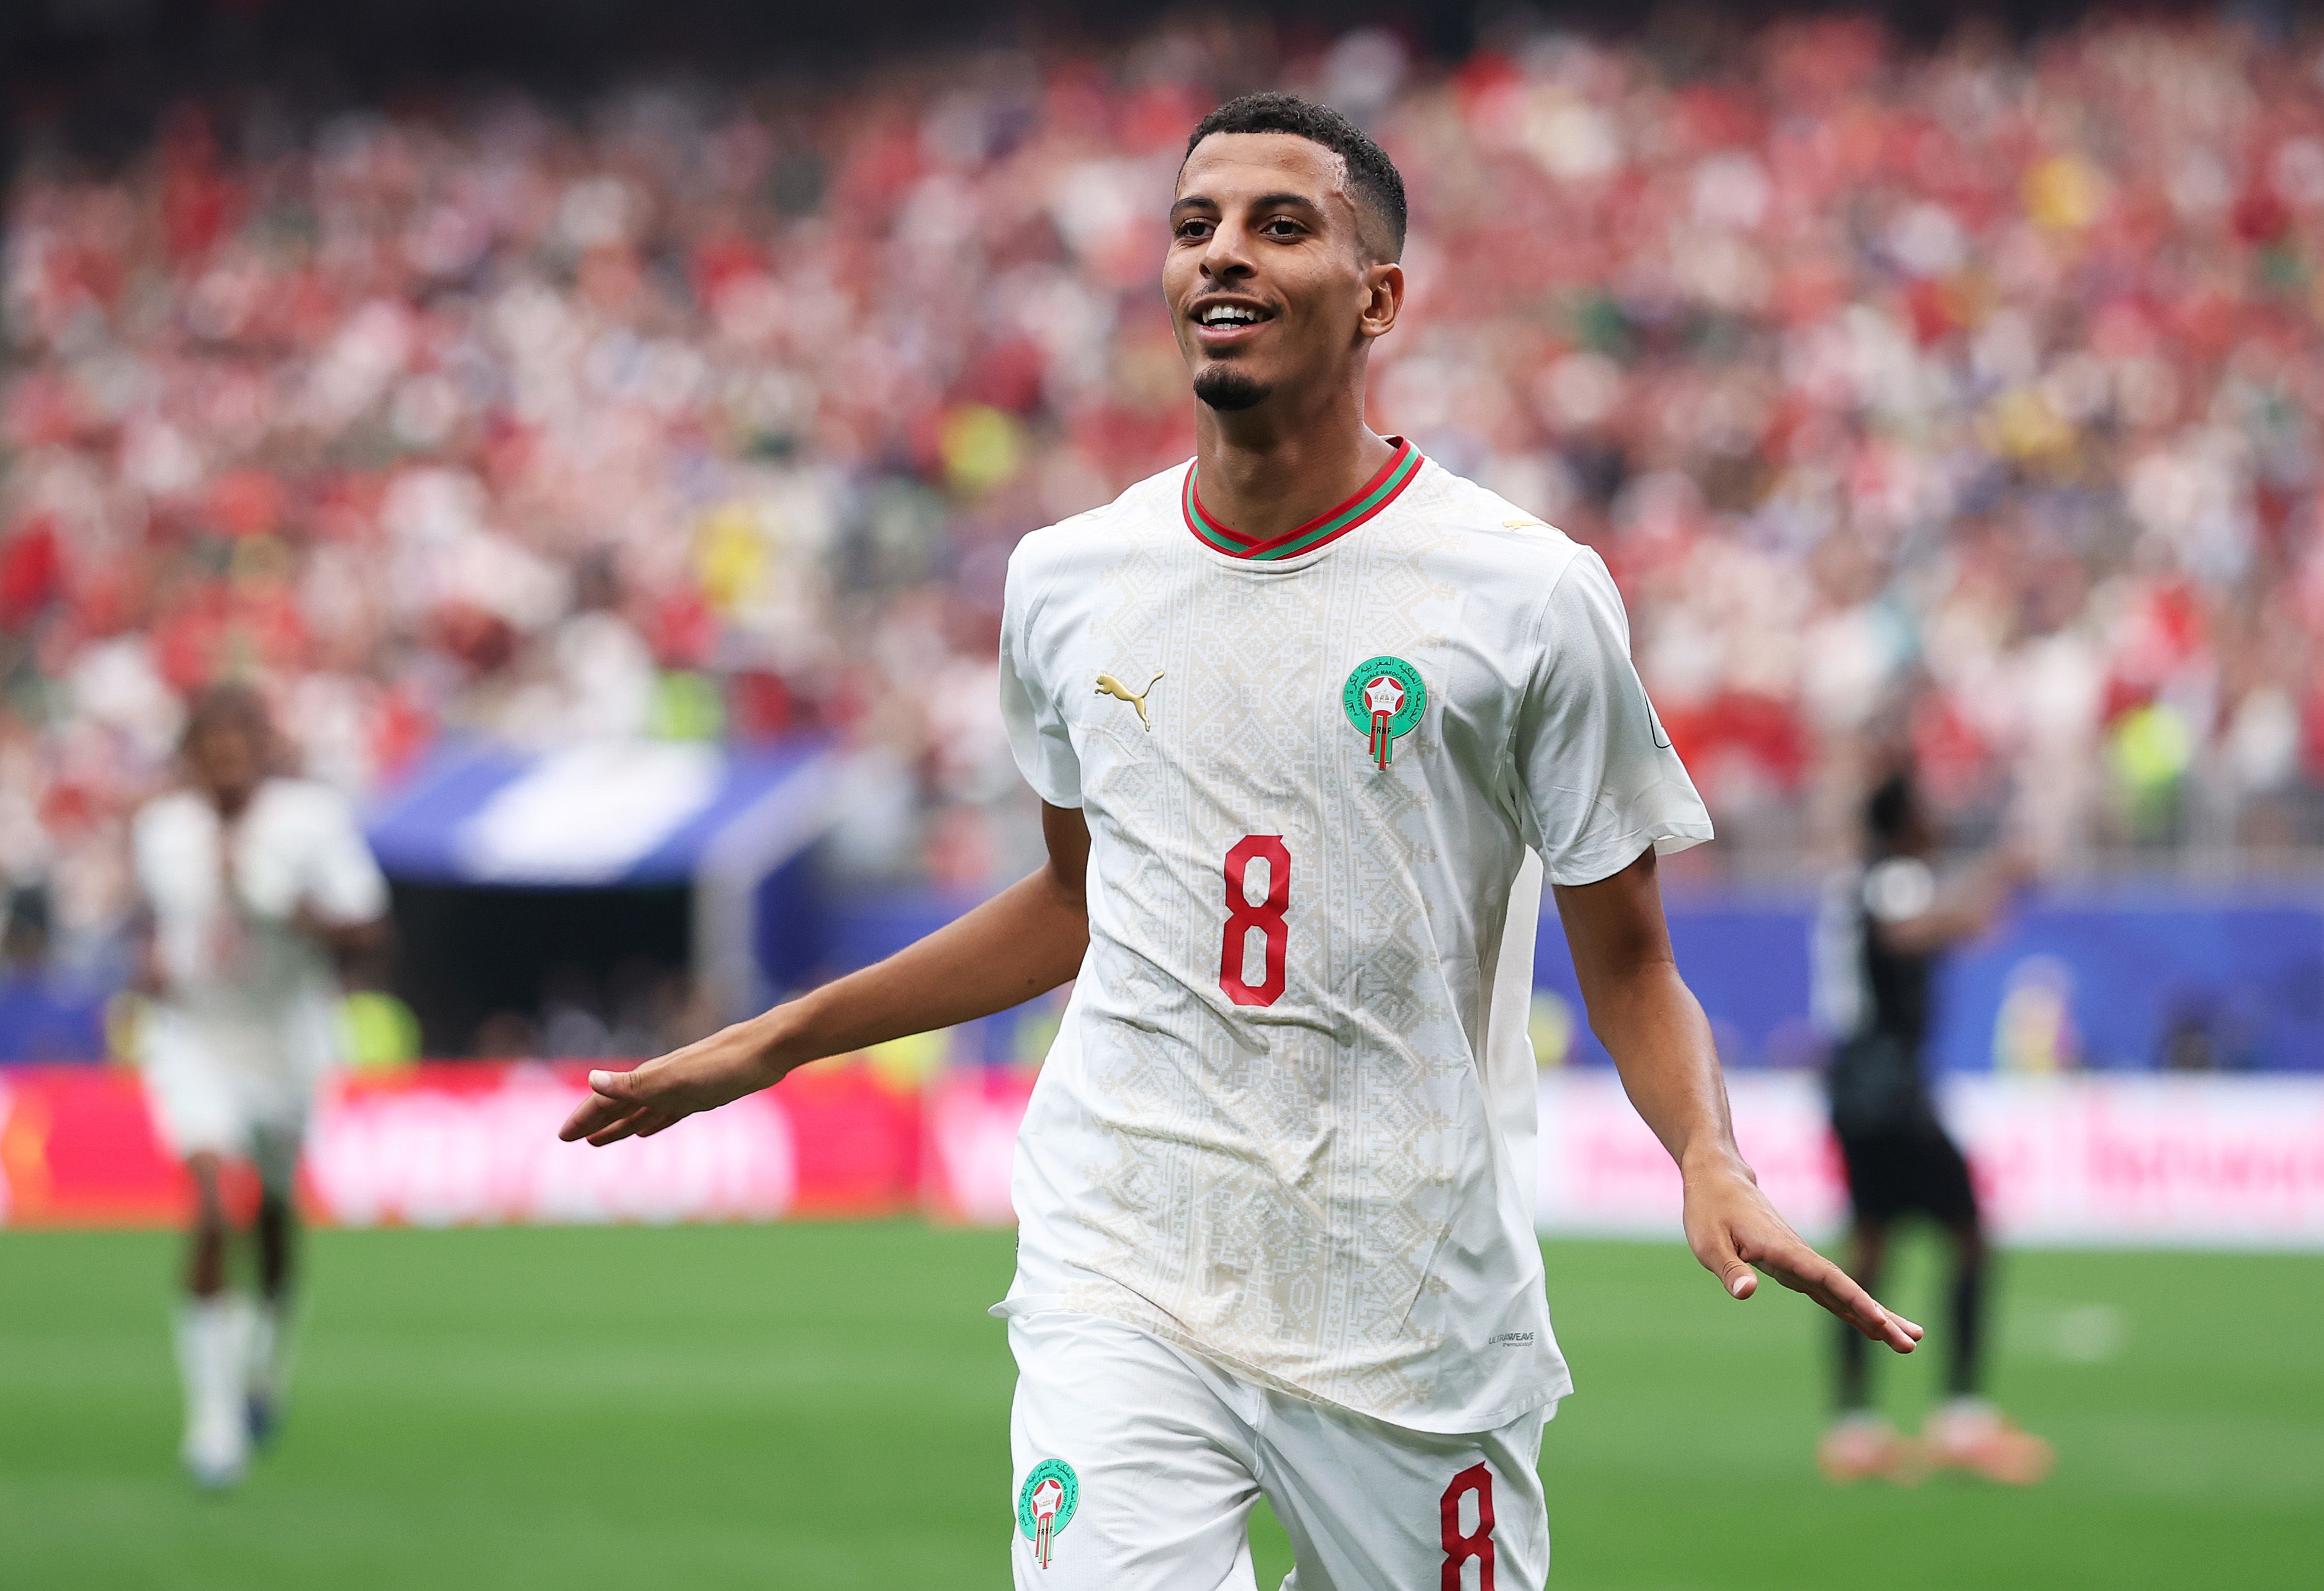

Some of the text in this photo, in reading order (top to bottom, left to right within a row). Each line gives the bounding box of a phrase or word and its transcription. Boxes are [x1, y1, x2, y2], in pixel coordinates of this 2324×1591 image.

[1345, 658, 1425, 724] الجامعة الملكية المغربية لكرة القدم
[1361, 671, 1380, 686] ROYALE
[1381, 670, 1409, 686] MAROCAINE
[1396, 696, 1412, 720] FOOTBALL
[1371, 726, 1392, 735] FRMF
[1219, 835, 1291, 1007] 8
[1489, 1332, 1534, 1344] ULTRAWEAVE
[1440, 1460, 1495, 1591] 8
